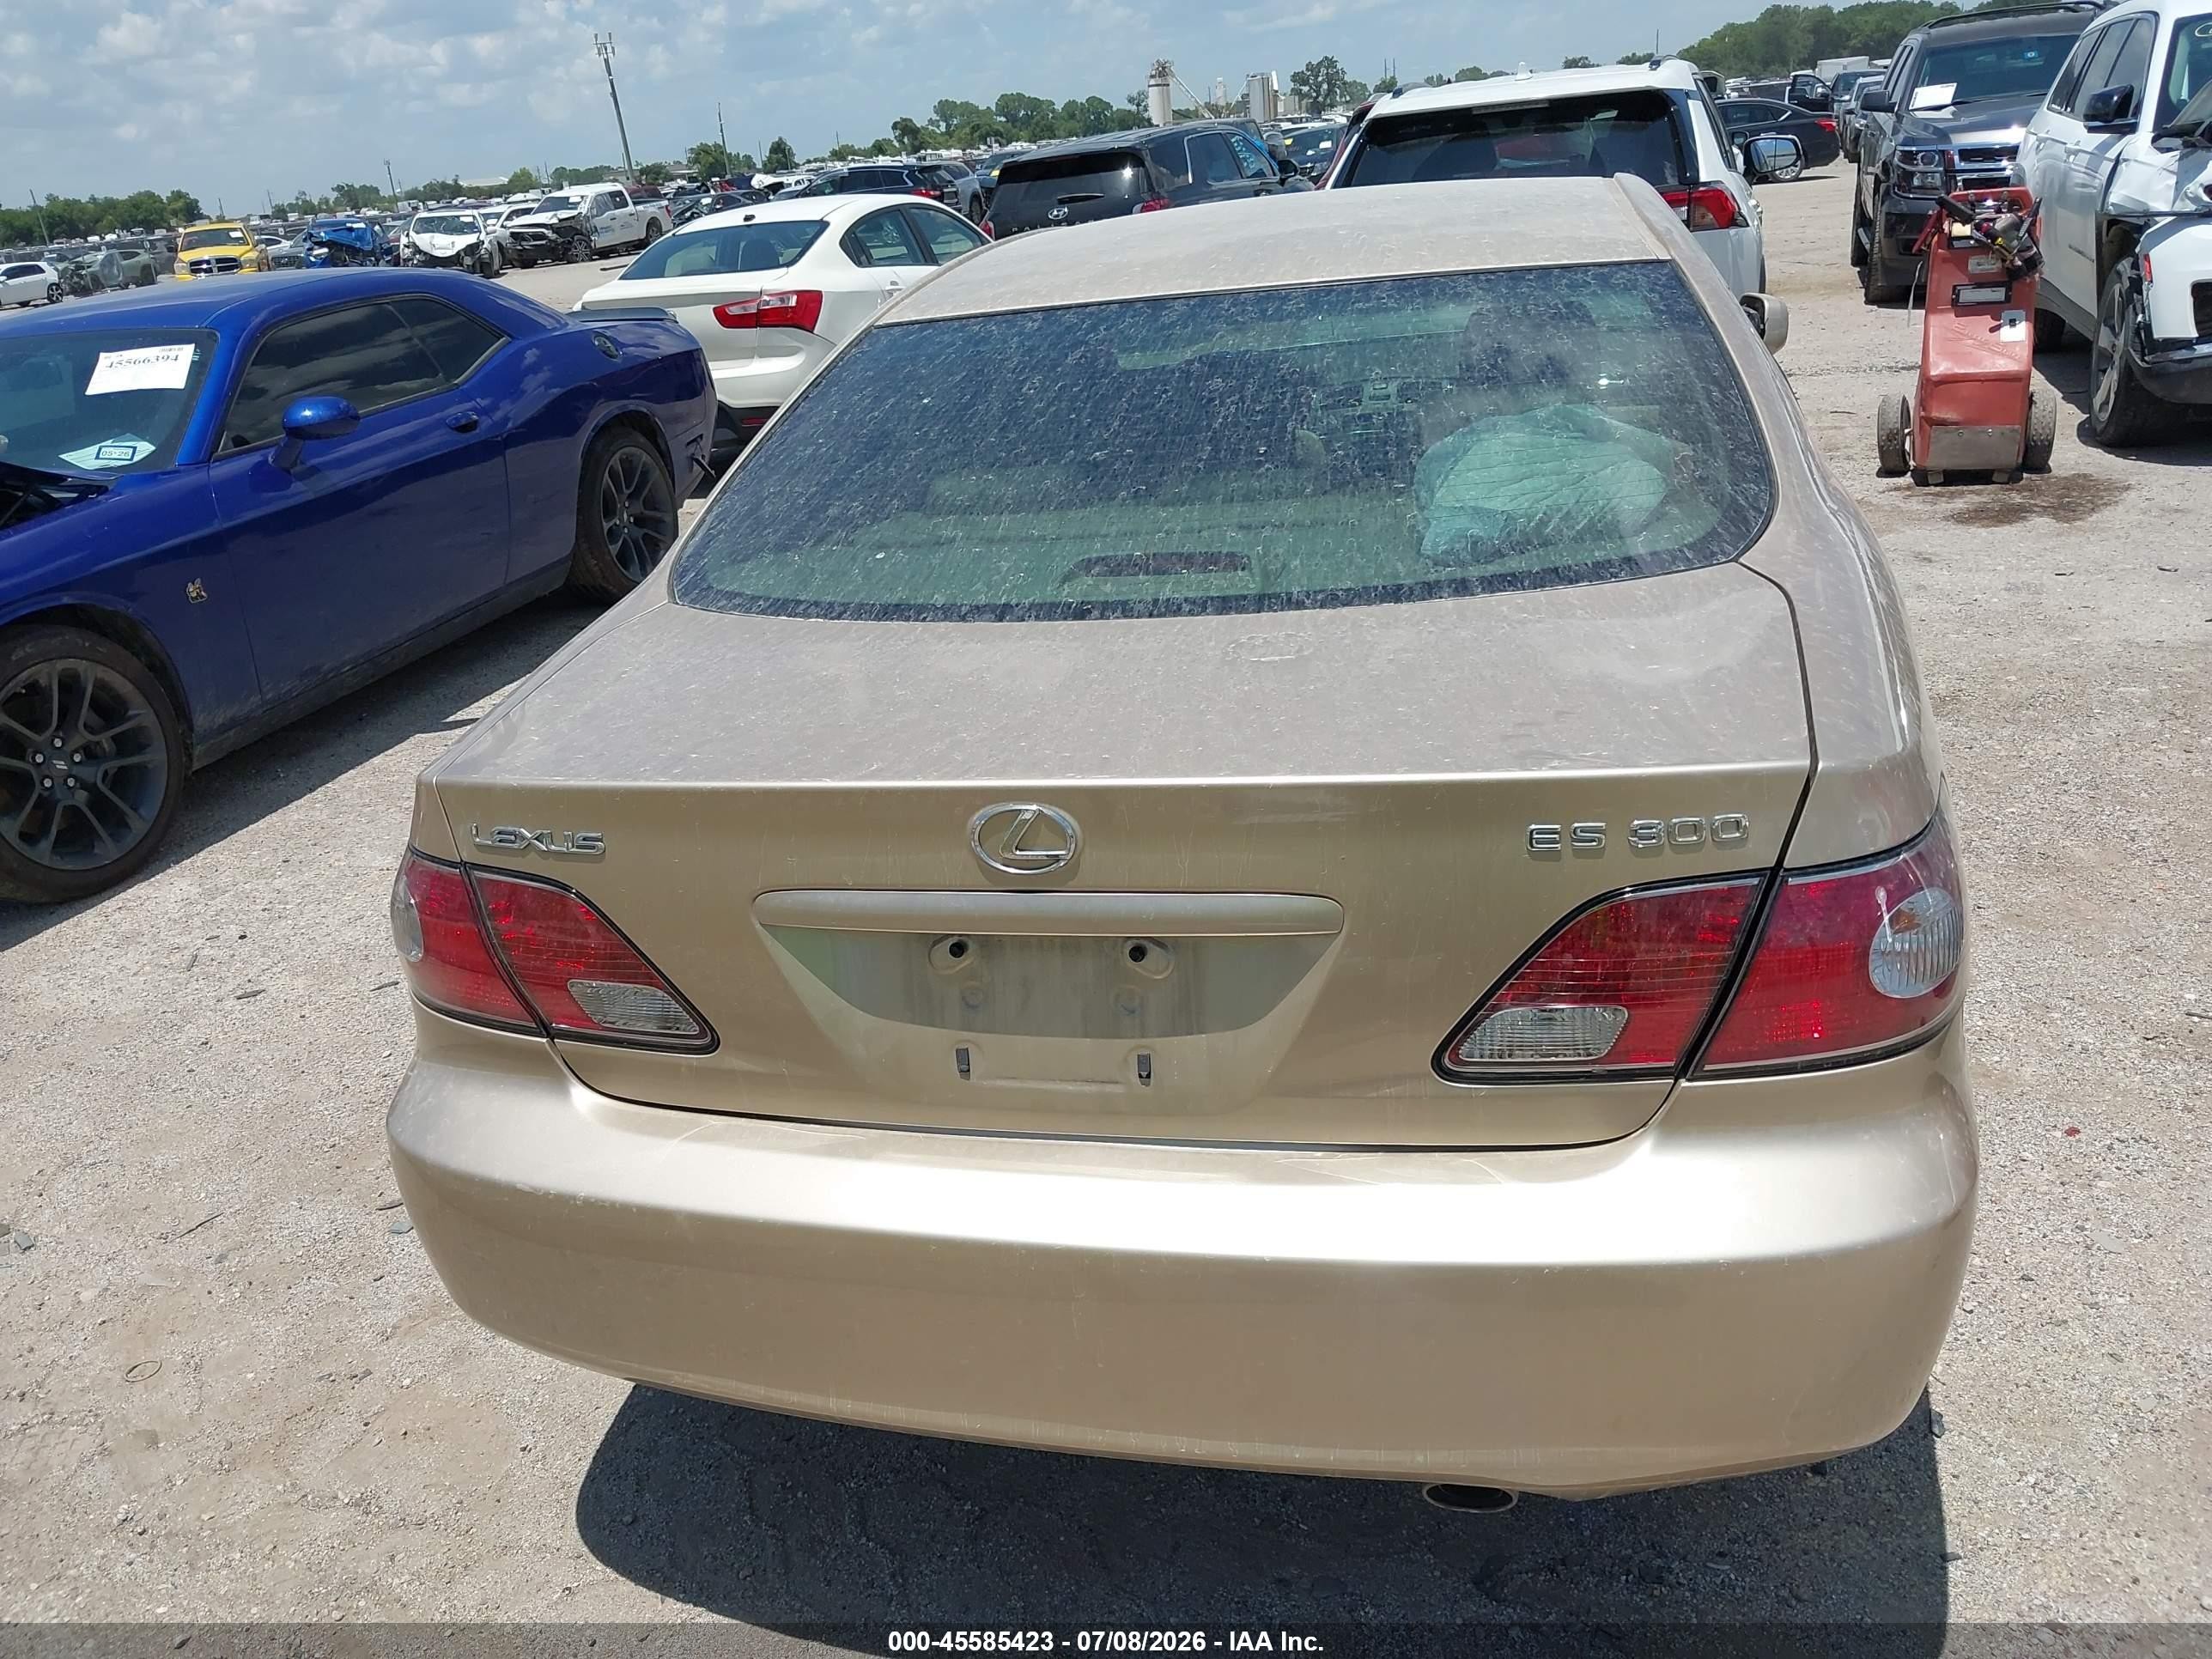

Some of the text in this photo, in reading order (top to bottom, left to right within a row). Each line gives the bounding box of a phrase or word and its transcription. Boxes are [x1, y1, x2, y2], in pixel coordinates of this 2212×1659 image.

[471, 823, 605, 855] LEXUS
[1526, 814, 1750, 851] ES 300
